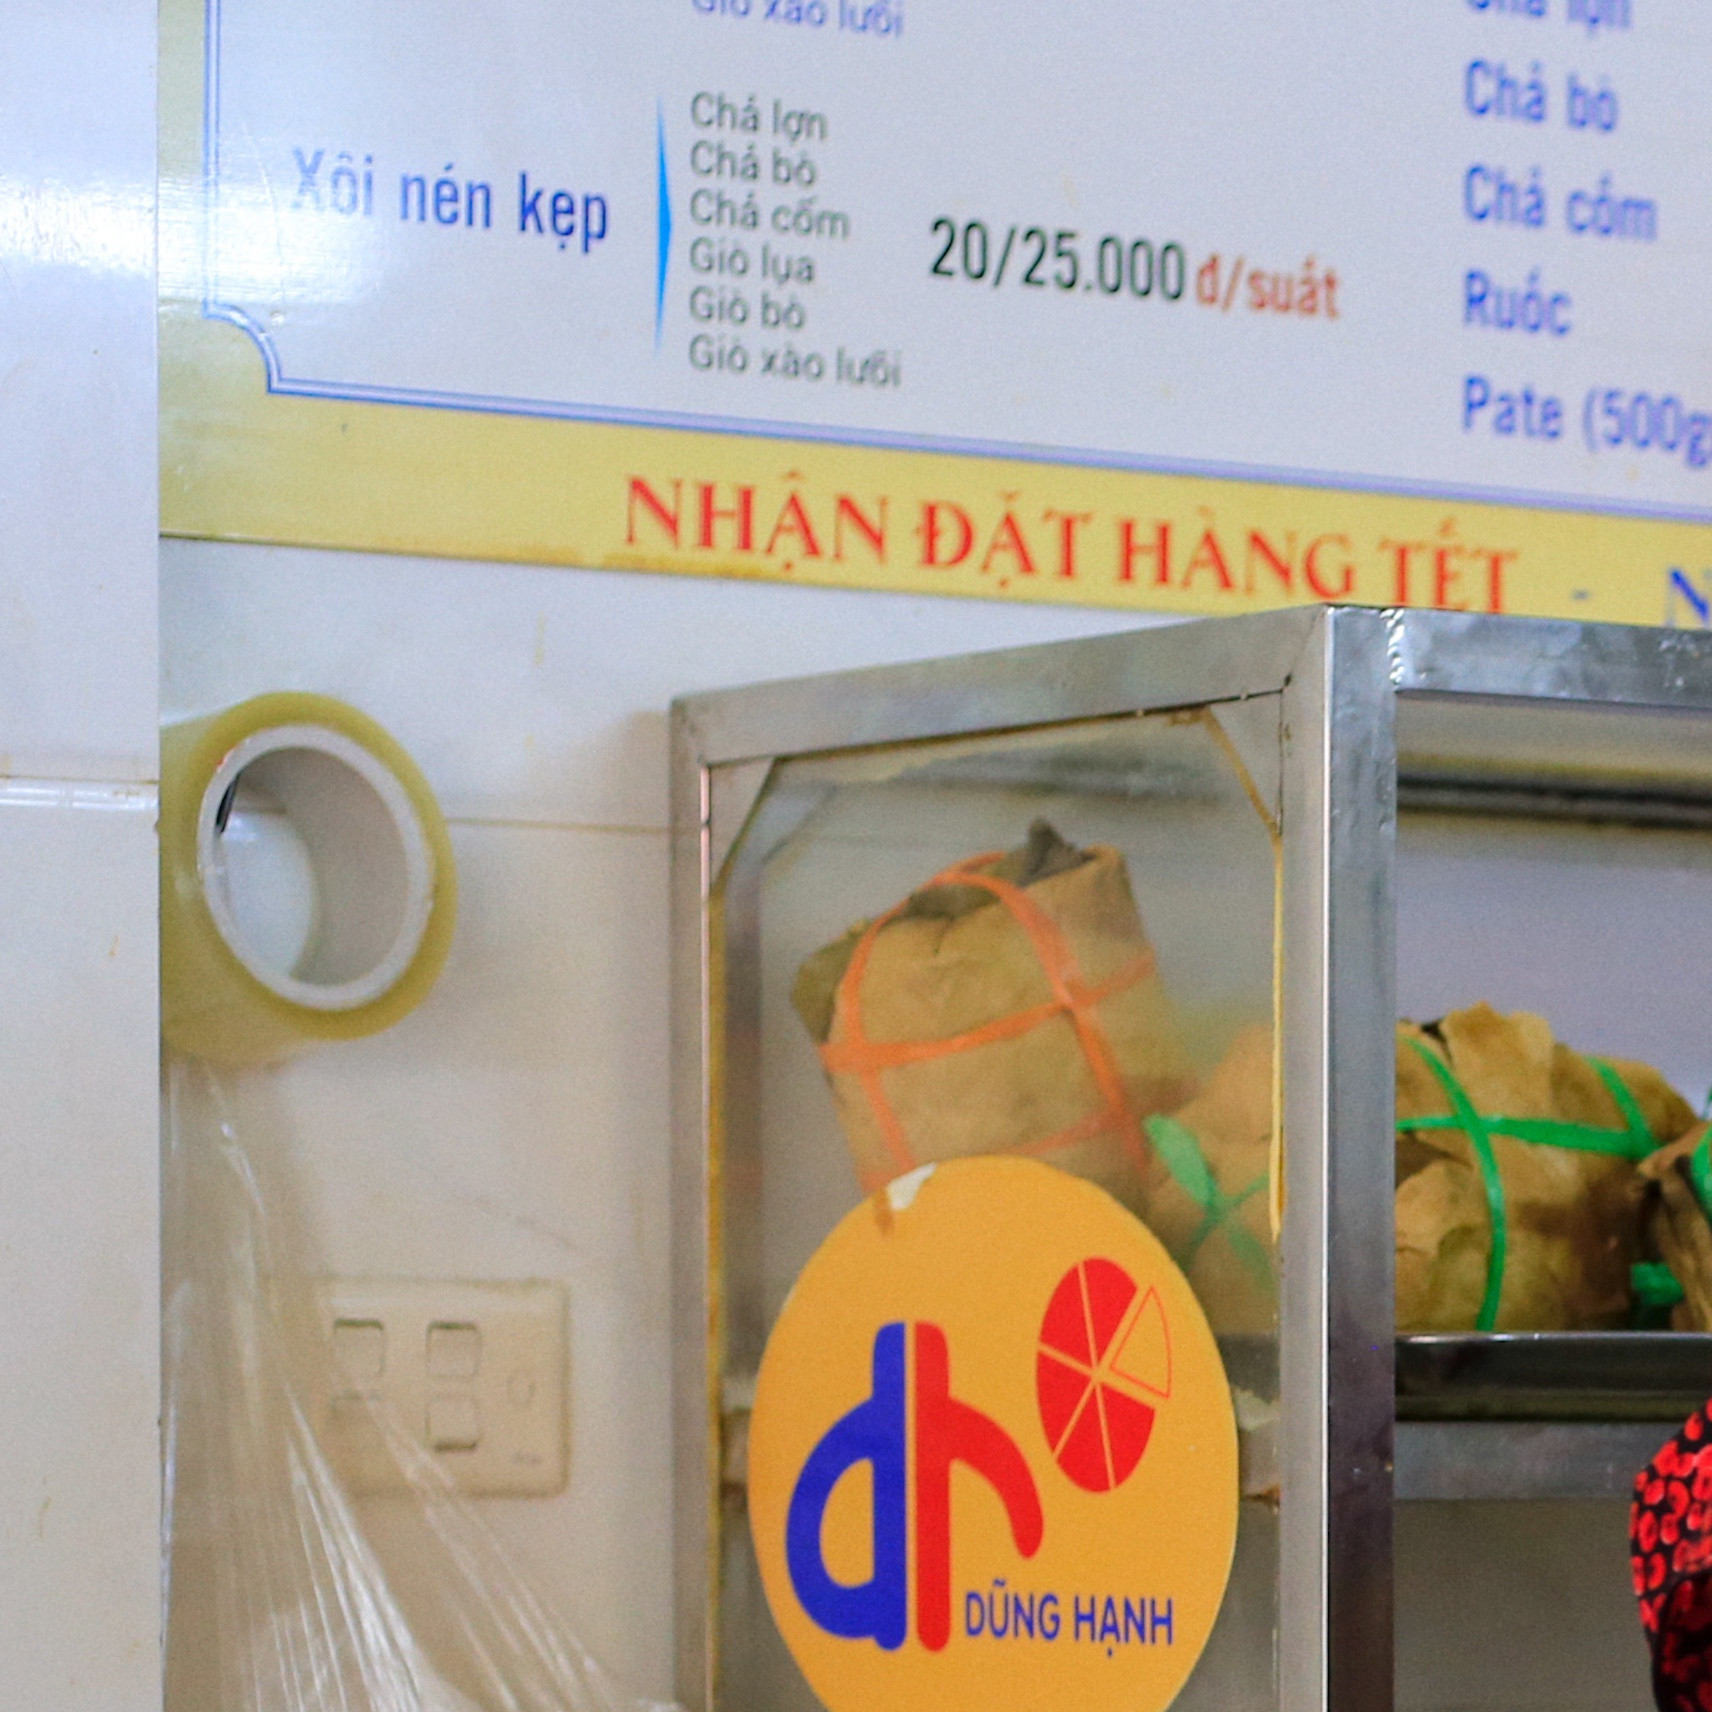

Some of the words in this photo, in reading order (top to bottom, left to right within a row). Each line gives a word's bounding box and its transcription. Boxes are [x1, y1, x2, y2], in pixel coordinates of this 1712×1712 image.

[401, 163, 492, 230] nén
[519, 171, 608, 254] kẹp
[931, 217, 1186, 301] 20/25.000
[1464, 373, 1562, 440] Pate
[625, 470, 889, 574] NHẬN
[915, 490, 1095, 590] ĐẶT
[1116, 504, 1355, 601] HÀNG
[1377, 517, 1519, 614] TẾT
[965, 1578, 1060, 1641] DŨNG
[1073, 1595, 1173, 1657] HẠNH
